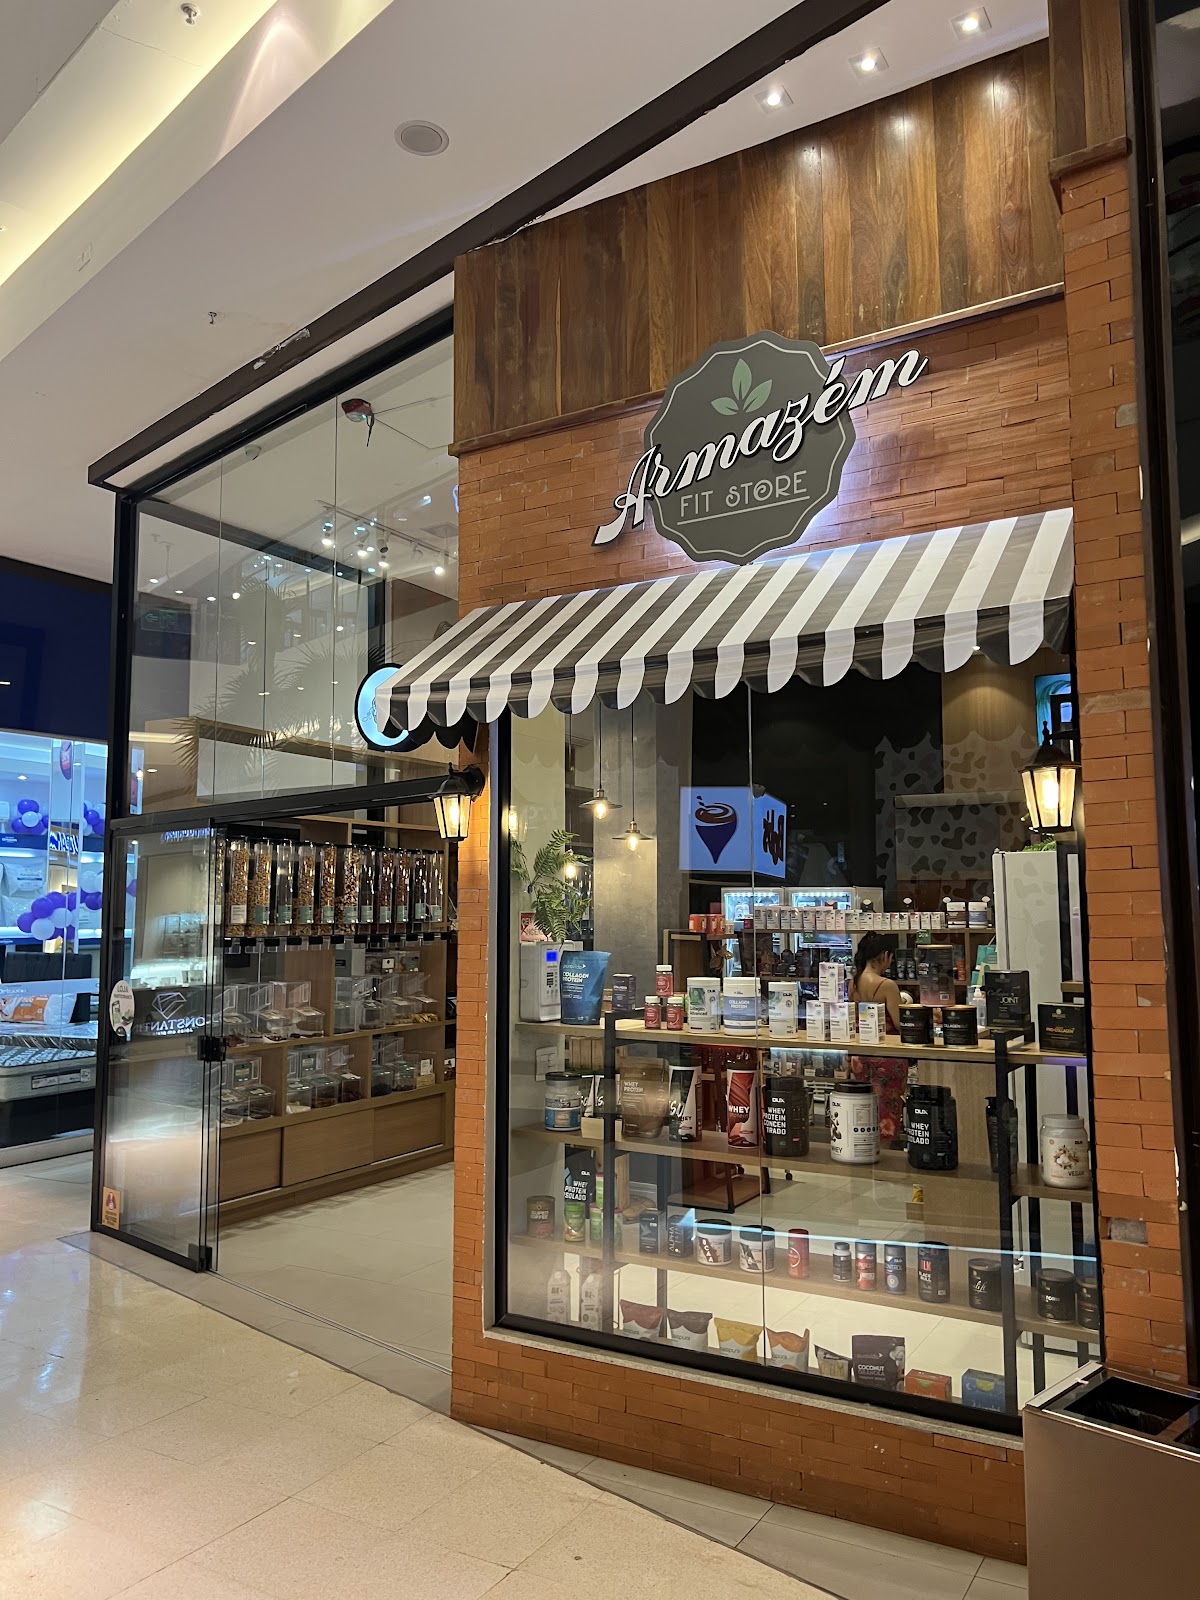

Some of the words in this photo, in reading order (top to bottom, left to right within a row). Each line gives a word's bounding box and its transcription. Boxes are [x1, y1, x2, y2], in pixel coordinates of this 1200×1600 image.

[591, 349, 928, 546] Armazém
[680, 491, 713, 517] FIT
[725, 470, 808, 508] STORE
[728, 1105, 750, 1114] WHEY
[768, 1106, 786, 1115] WHEY
[766, 1126, 787, 1135] TRADO
[911, 1122, 930, 1130] WHEY
[564, 1185, 588, 1195] PROTEIN
[858, 1364, 885, 1372] COCONUT
